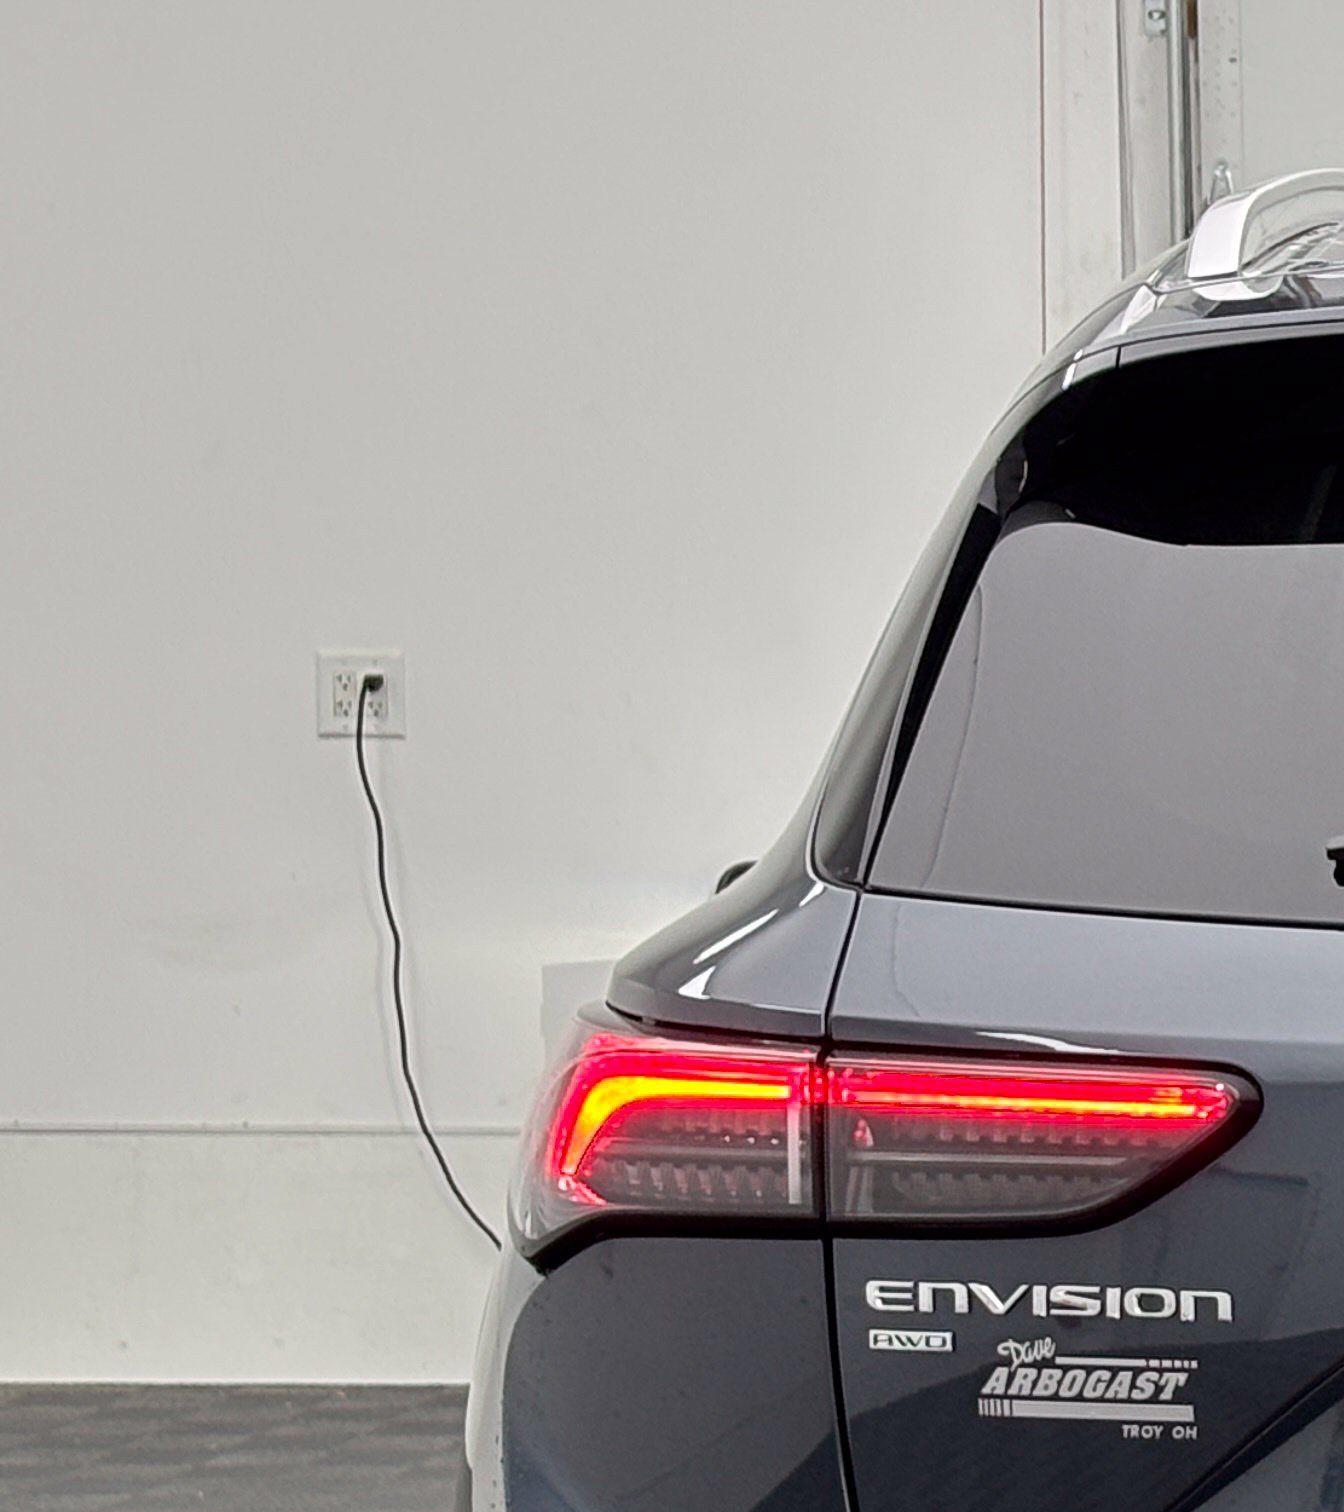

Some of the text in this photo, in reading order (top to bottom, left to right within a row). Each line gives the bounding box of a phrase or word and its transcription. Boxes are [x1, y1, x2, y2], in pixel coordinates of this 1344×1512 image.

[865, 1280, 1233, 1322] ENVISION
[873, 1333, 948, 1349] AWD
[997, 1335, 1056, 1370] Dave
[980, 1366, 1188, 1401] ARBOGAST
[1122, 1424, 1197, 1440] TROY OH
